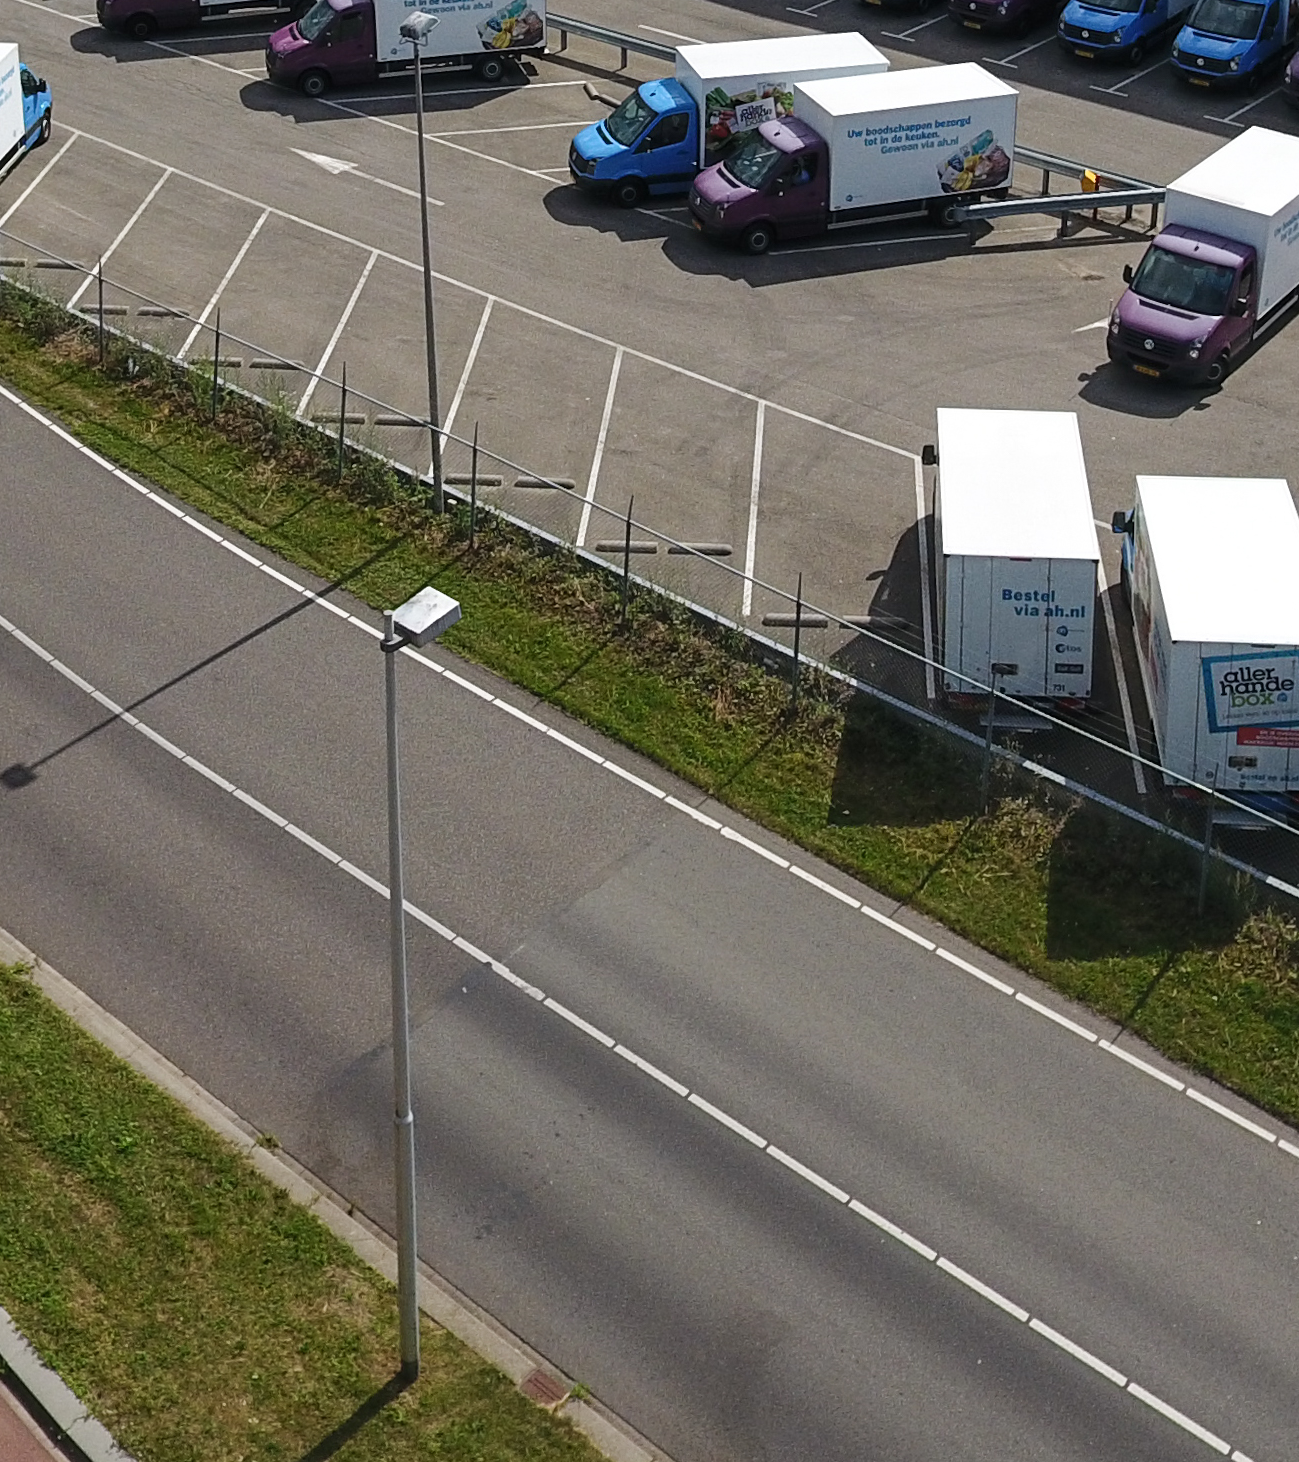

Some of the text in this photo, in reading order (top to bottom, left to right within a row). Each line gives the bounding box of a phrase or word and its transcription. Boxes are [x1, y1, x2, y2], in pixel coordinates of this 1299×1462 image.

[847, 116, 971, 139] Uw boodschappen bezorgd
[864, 131, 940, 147] tot in de keuken.
[880, 136, 959, 154] Gewoon via ah.nl
[1002, 589, 1055, 602] Bestel
[1014, 604, 1086, 618] via ah.nl
[1223, 667, 1275, 683] aller
[1219, 676, 1294, 696] hande
[1231, 692, 1274, 708] box
